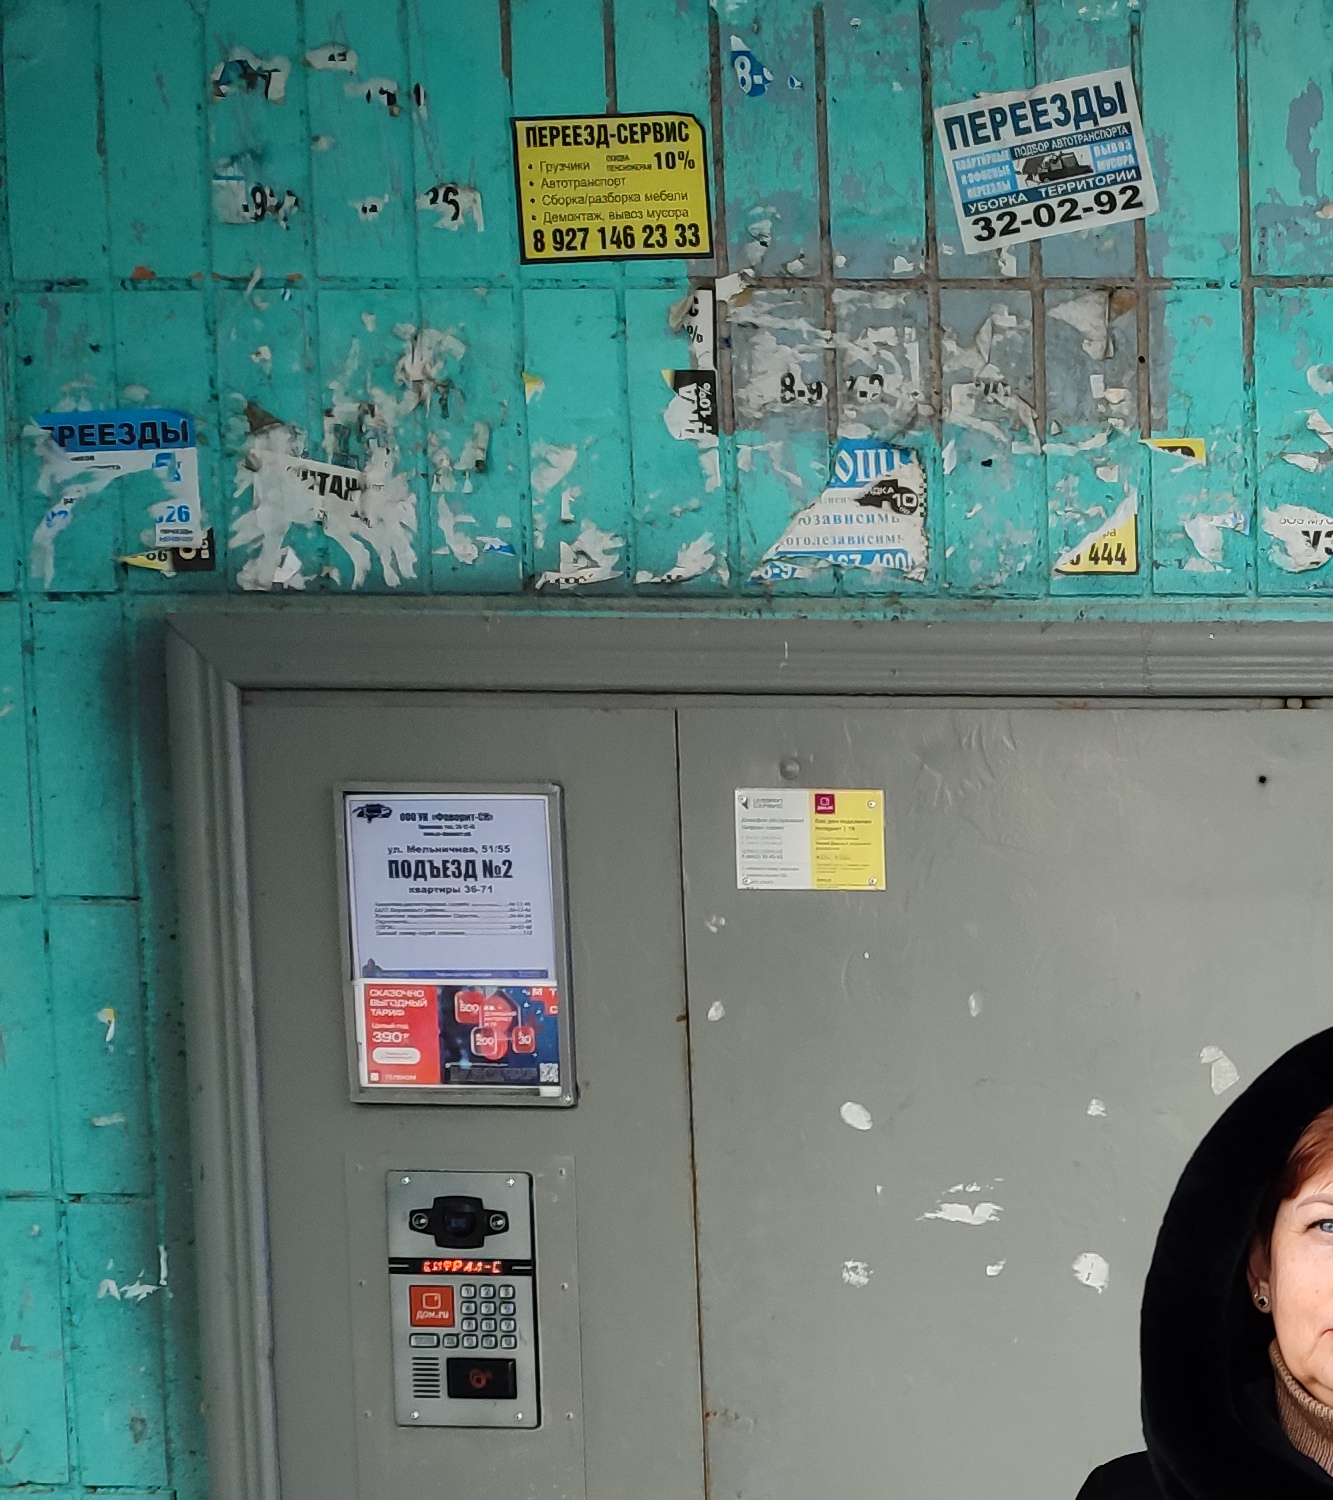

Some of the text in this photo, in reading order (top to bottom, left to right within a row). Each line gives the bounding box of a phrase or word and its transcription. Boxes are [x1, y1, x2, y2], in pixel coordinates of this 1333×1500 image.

[943, 80, 1128, 151] ПЕРЕЕЗДЫ
[525, 121, 690, 148] ПЕРЕЕЗД-СЕРВИС
[1051, 125, 1131, 149] АВТОТРАНСПОРТА
[539, 160, 590, 174] Грузчики
[654, 151, 696, 170] 10%
[541, 177, 626, 190] Автотранспорт
[968, 168, 1138, 214] УБОРКА ТЕРРИТОРИИ
[541, 191, 688, 208] Сборка/разборка мебели
[609, 209, 643, 220] вывоз
[647, 207, 690, 220] мусора
[971, 185, 1144, 242] 32-02-92
[533, 223, 701, 252] 8 927 146 23 33
[1088, 542, 1128, 566] 444
[387, 844, 511, 855] ул. Мельничная, 51/55
[387, 858, 513, 881] ПОДЪЕЗД №2
[408, 884, 493, 895] квартиры 36-71
